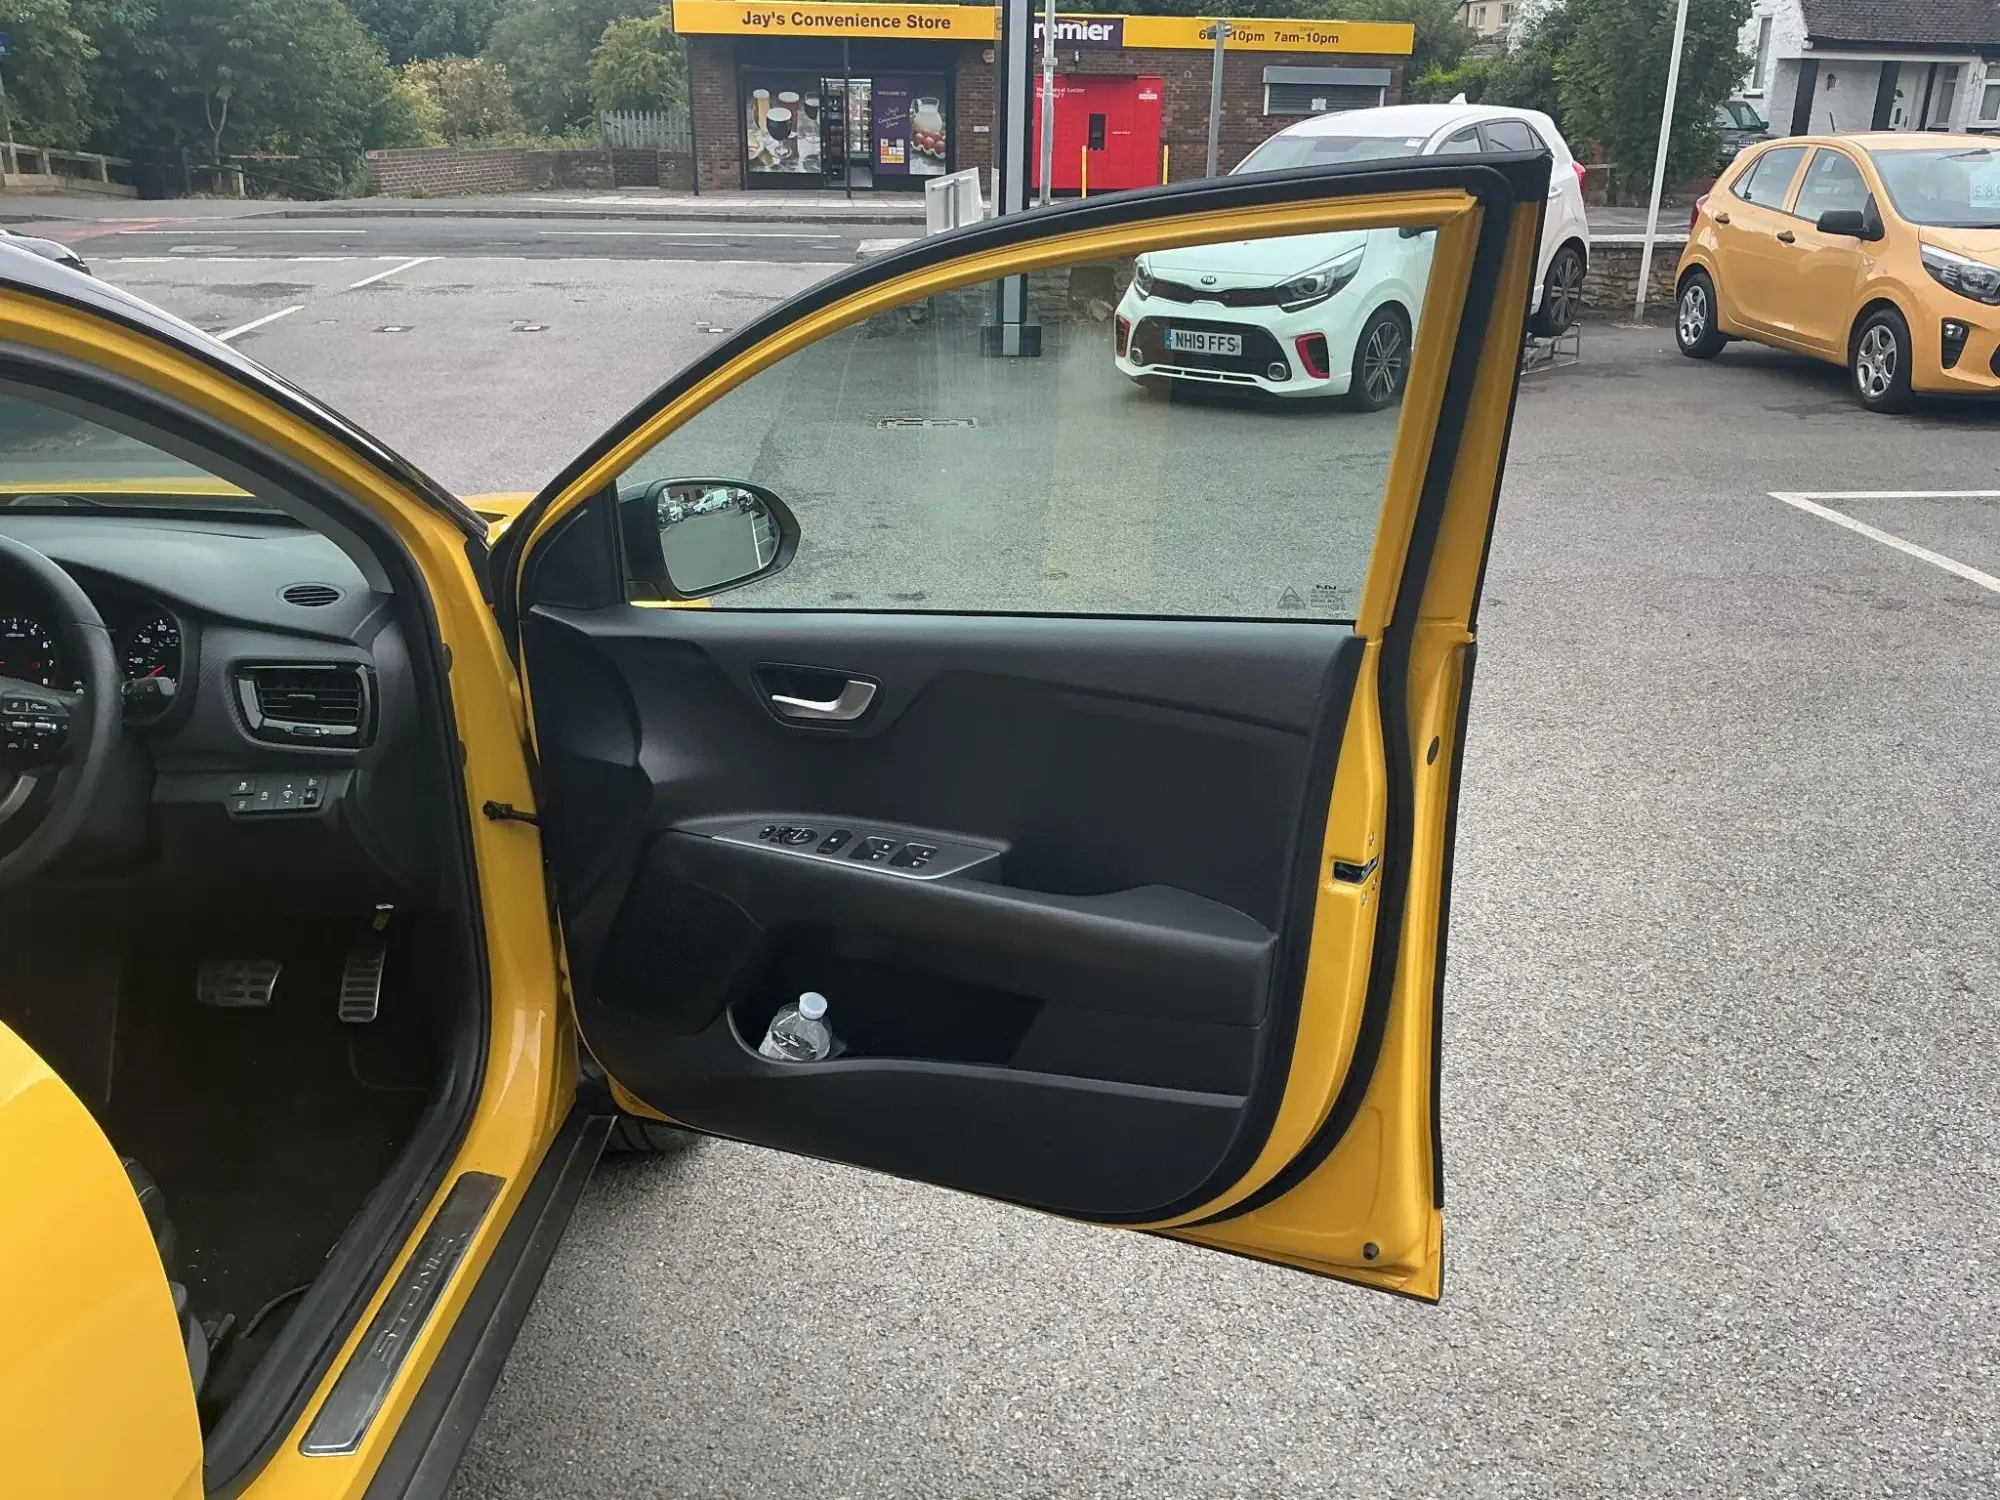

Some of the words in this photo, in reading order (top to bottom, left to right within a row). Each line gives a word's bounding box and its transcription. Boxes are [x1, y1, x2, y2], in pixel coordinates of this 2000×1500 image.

[742, 11, 785, 28] Jay's
[791, 11, 901, 28] Convenience
[906, 14, 951, 29] Store
[1033, 20, 1113, 40] rmier
[1198, 29, 1265, 43] 610pm
[1273, 31, 1339, 44] 7am-10pm
[1202, 275, 1215, 284] KIA
[1175, 332, 1205, 350] NH19
[1208, 335, 1236, 352] FFS
[42, 641, 49, 649] 6
